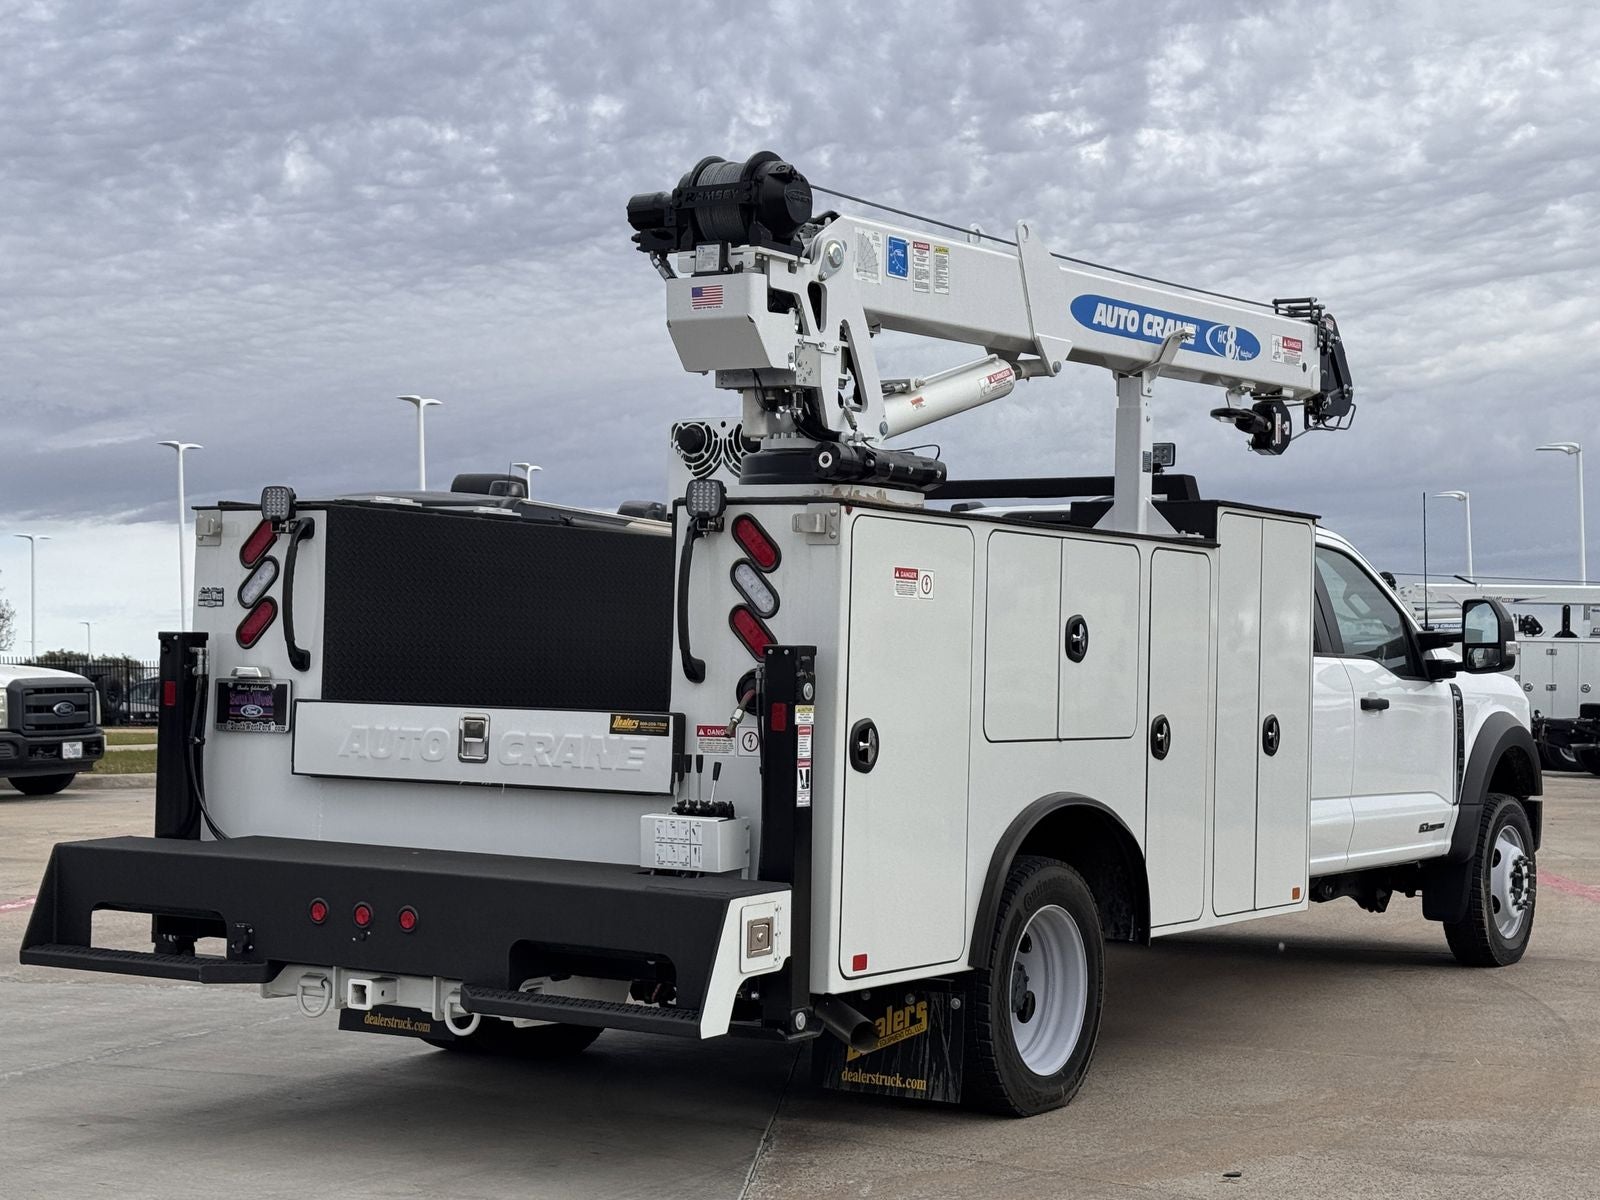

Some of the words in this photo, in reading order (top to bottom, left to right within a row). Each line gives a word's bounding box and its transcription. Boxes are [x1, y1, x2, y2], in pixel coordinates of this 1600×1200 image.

[686, 189, 738, 202] RAMSEY
[1093, 302, 1139, 333] AUTO
[901, 571, 917, 579] DANGER
[612, 715, 640, 729] Dealers
[707, 728, 727, 736] DANG
[338, 724, 450, 763] AUTO
[498, 731, 647, 771] CRANE
[364, 1012, 431, 1033] dealerstruck.com
[841, 1067, 927, 1091] dealerstruck.com
